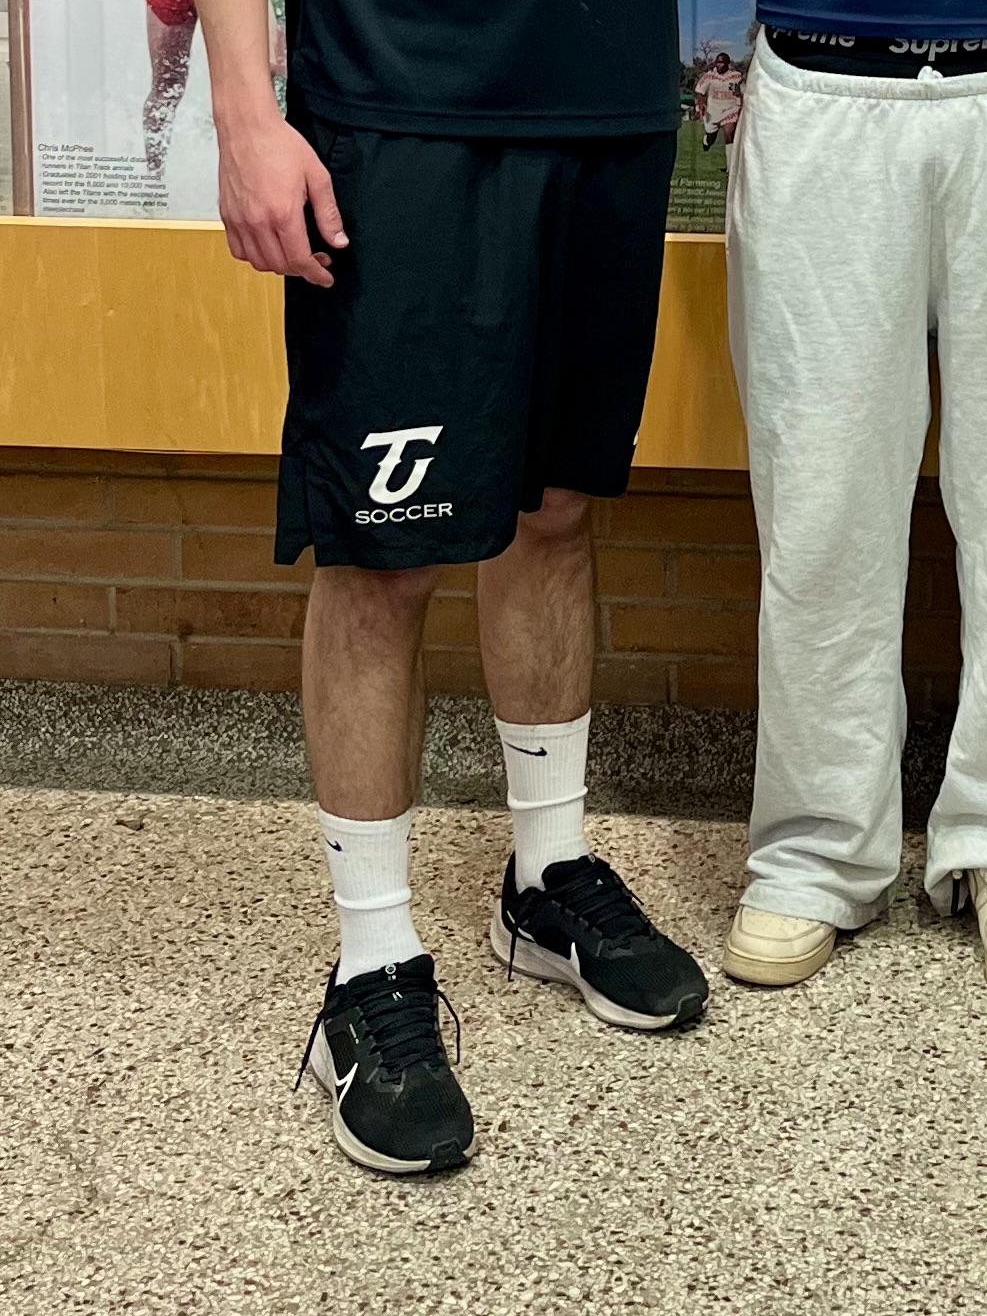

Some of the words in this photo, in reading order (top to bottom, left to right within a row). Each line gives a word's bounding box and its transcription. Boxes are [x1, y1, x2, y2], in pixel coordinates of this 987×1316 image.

[37, 143, 59, 152] Chris
[61, 144, 94, 153] McPhee
[42, 171, 76, 179] Graduated
[354, 502, 454, 525] SOCCER
